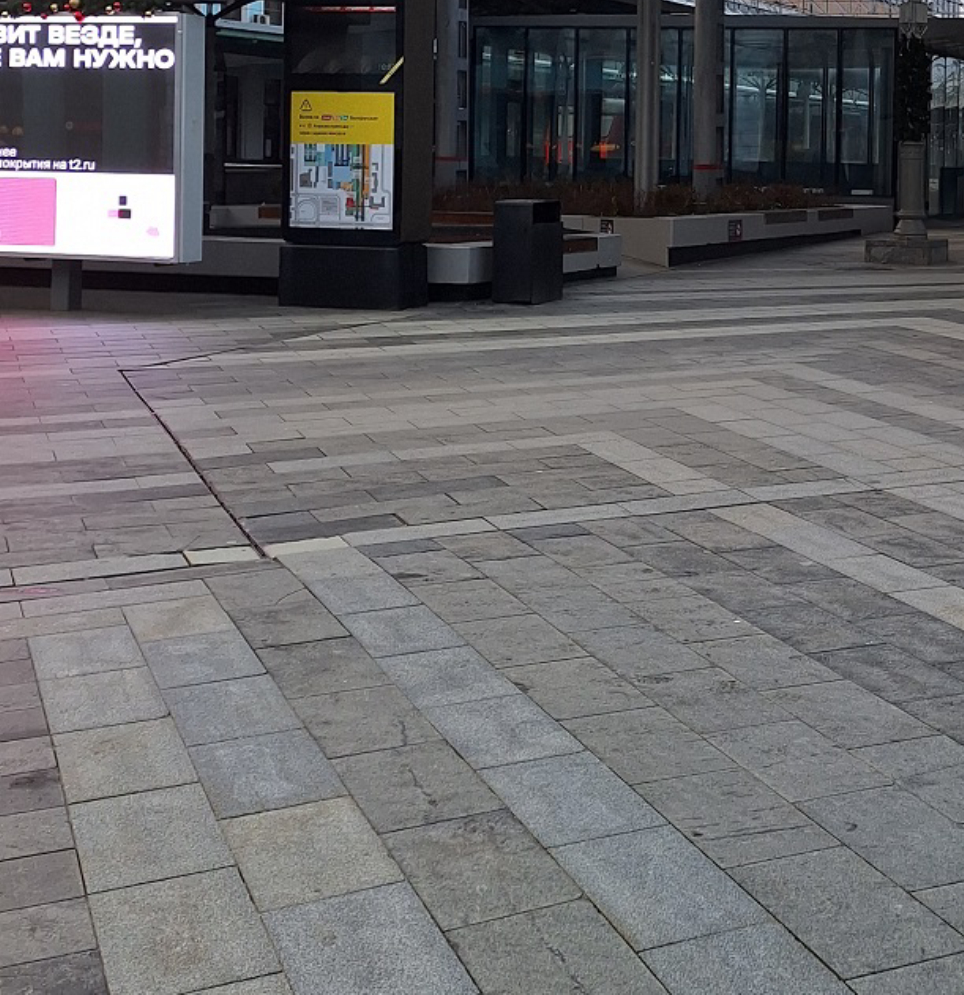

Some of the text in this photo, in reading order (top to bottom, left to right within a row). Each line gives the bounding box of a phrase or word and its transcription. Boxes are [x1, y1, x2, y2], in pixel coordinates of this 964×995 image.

[48, 24, 142, 48] ВЕЗДЕ,
[8, 48, 66, 68] ВАМ
[73, 50, 175, 69] НУЖНО
[0, 159, 95, 172] окрытия на t2.ru
